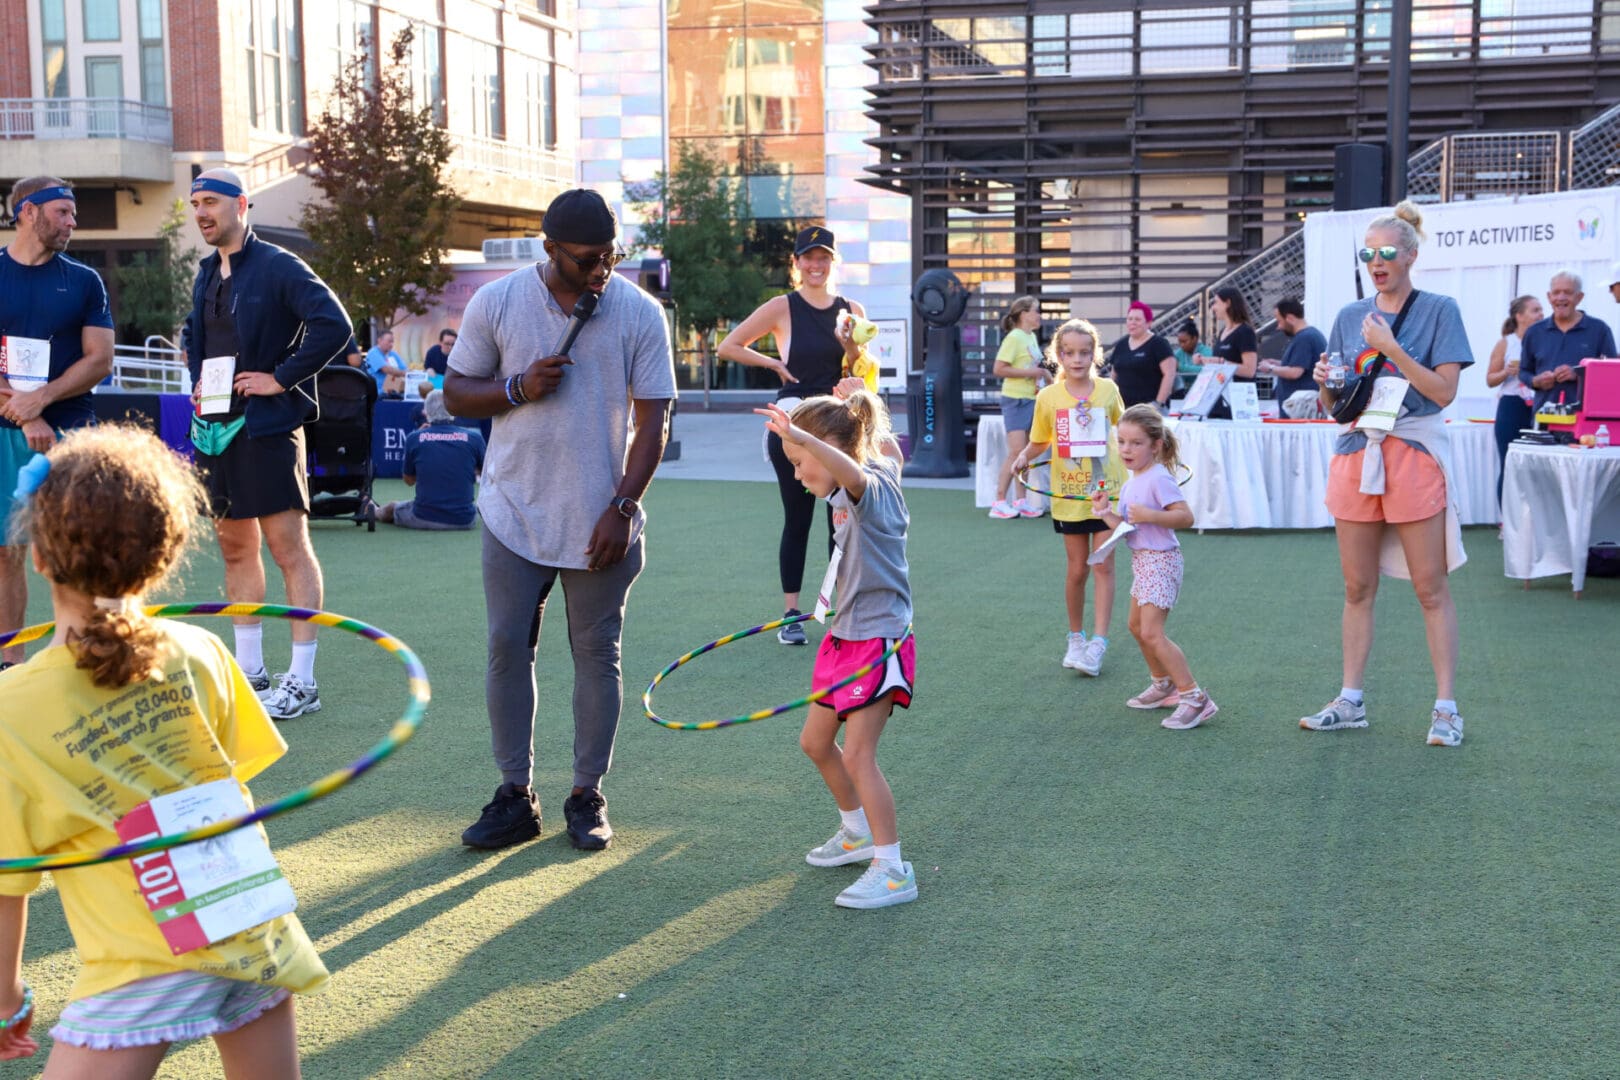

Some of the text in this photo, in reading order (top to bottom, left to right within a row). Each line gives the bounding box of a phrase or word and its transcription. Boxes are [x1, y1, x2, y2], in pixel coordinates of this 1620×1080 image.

[1435, 224, 1555, 248] TOT ACTIVITIES
[925, 377, 935, 432] ATOMIST
[1056, 417, 1069, 442] 2405
[1060, 471, 1092, 484] RACE
[1060, 479, 1120, 495] RESEACH
[149, 704, 195, 733] grants.
[65, 720, 109, 759] Funded
